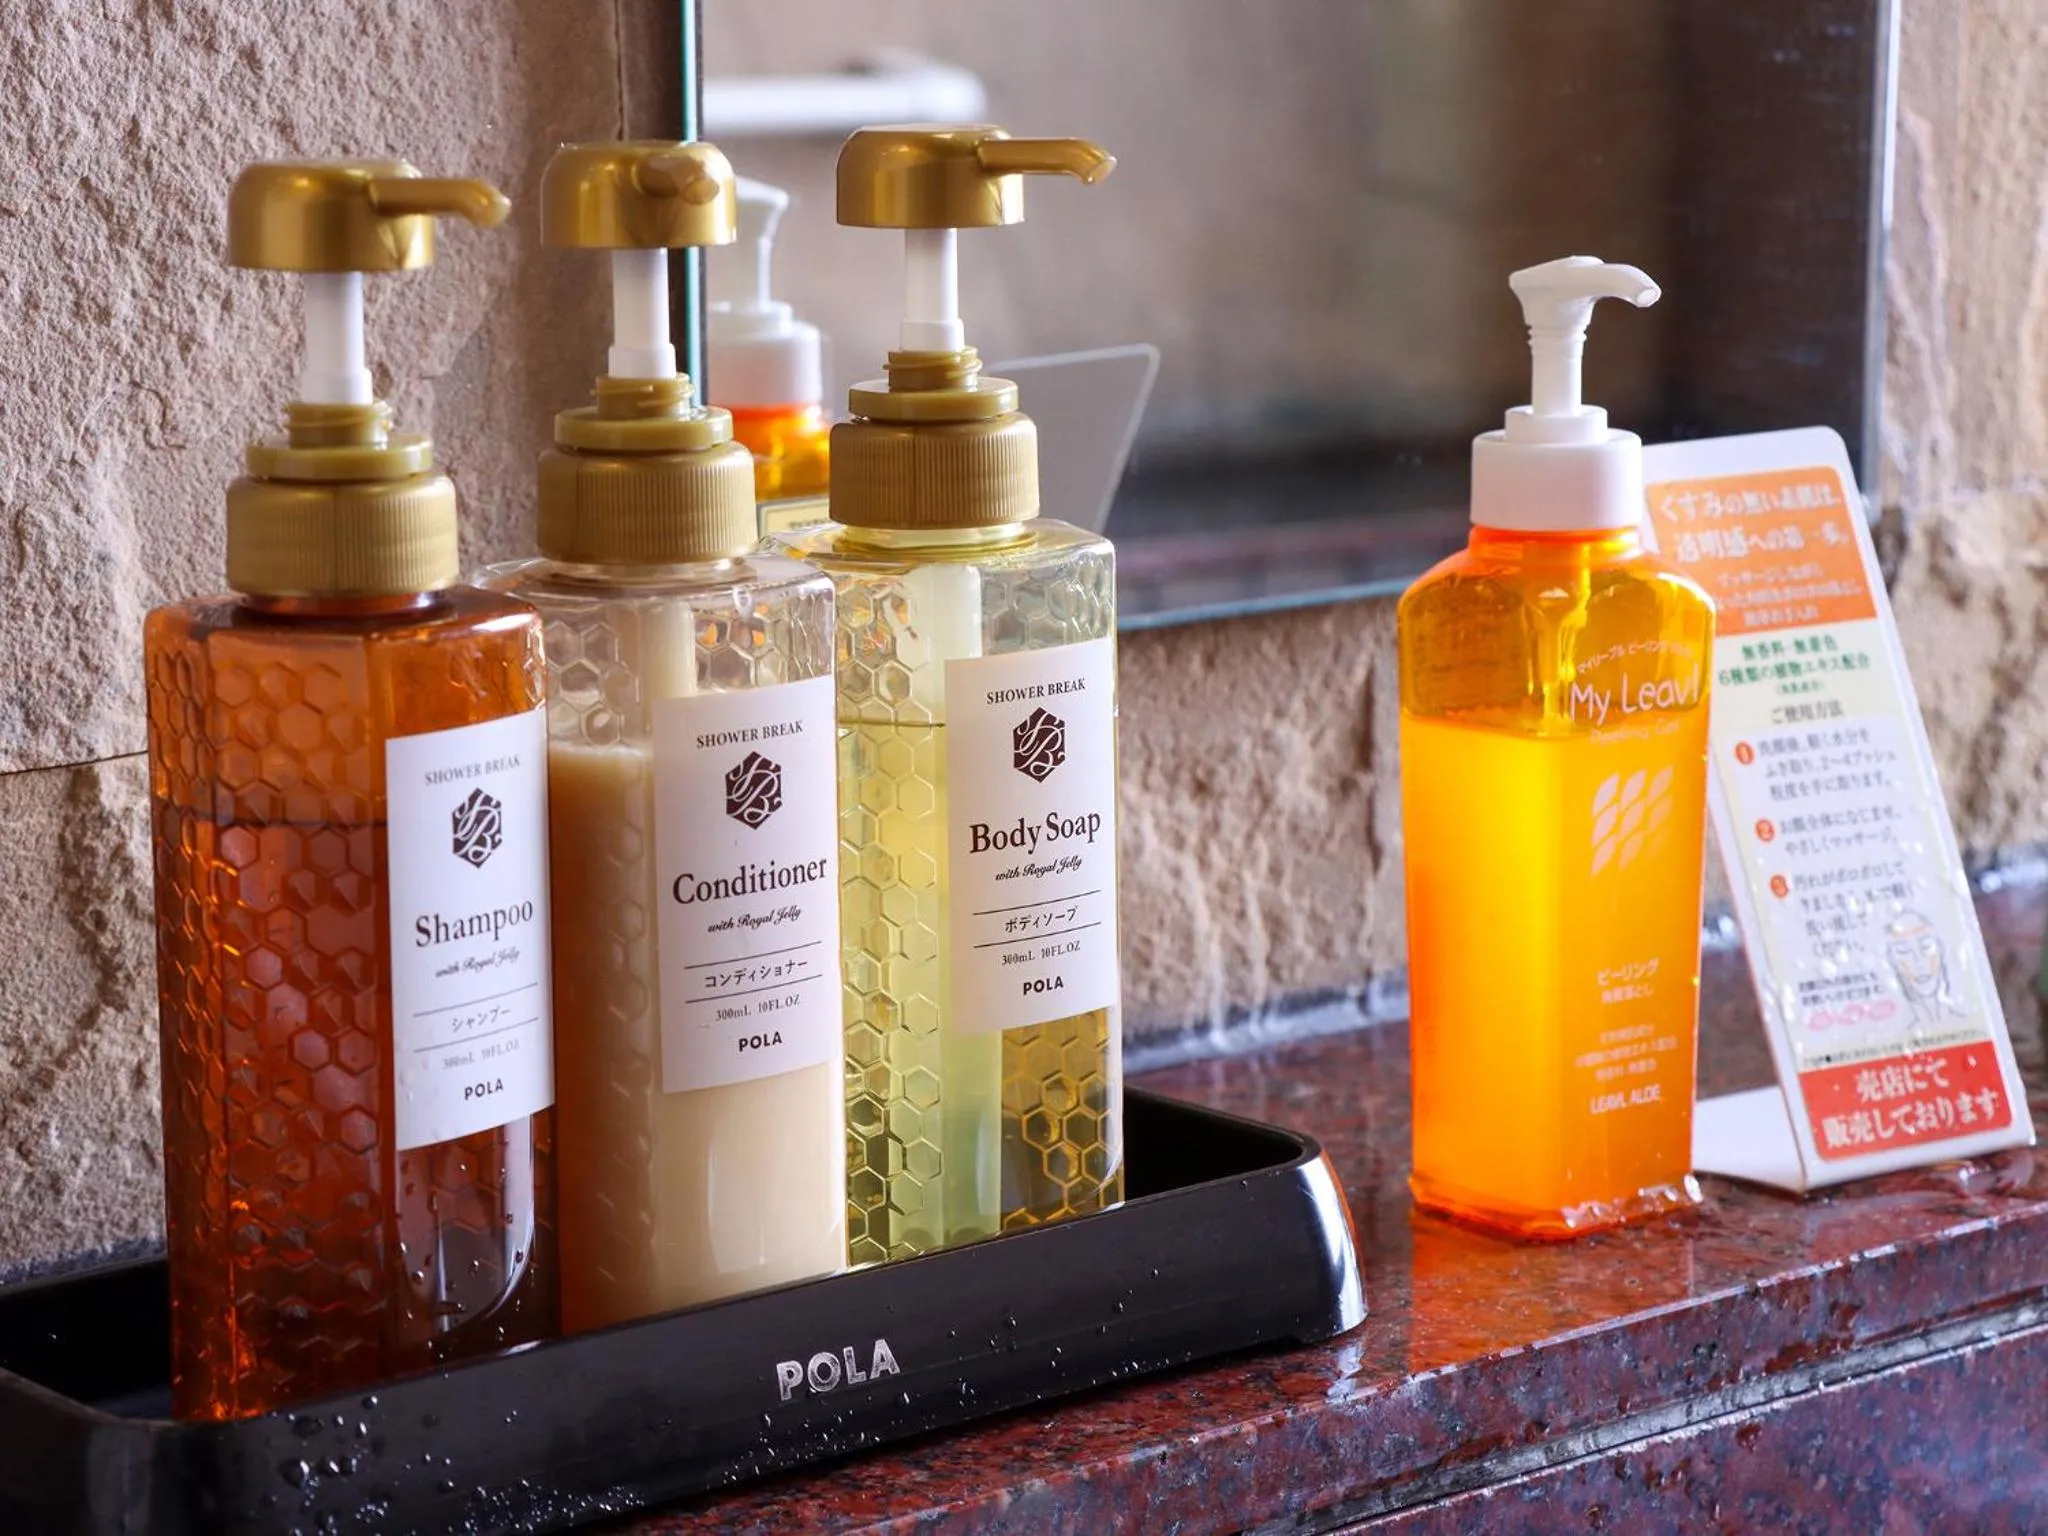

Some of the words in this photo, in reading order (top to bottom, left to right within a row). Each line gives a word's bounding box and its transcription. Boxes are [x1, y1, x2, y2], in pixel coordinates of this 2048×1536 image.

[986, 685, 1045, 705] SHOWER
[1047, 677, 1086, 696] BREAK
[1569, 681, 1612, 727] My
[1620, 662, 1700, 714] Leavl
[696, 728, 759, 750] SHOWER
[761, 720, 804, 740] BREAK
[424, 763, 482, 786] SHOWER
[485, 753, 521, 775] BREAK
[969, 817, 1042, 855] Body
[1045, 812, 1101, 844] Soap
[672, 857, 827, 905] Conditioner
[995, 866, 1021, 881] with
[1022, 859, 1058, 879] Royal
[1056, 854, 1082, 875] Jelly
[415, 900, 534, 948] Shampoo
[707, 916, 734, 933] with
[736, 909, 776, 930] Royal
[774, 904, 802, 925] Jelly
[1001, 950, 1036, 967] 300mL
[1596, 957, 1660, 986] ピーリング
[704, 959, 808, 988] コンディショナー
[1022, 975, 1065, 996] POLA
[715, 1004, 752, 1022] 300mL
[738, 1030, 783, 1053] POLA
[463, 1077, 504, 1102] POLA
[1855, 1056, 1950, 1103] 売店にて
[1821, 1086, 1999, 1149] 販売しております
[775, 1338, 901, 1401] POLA
